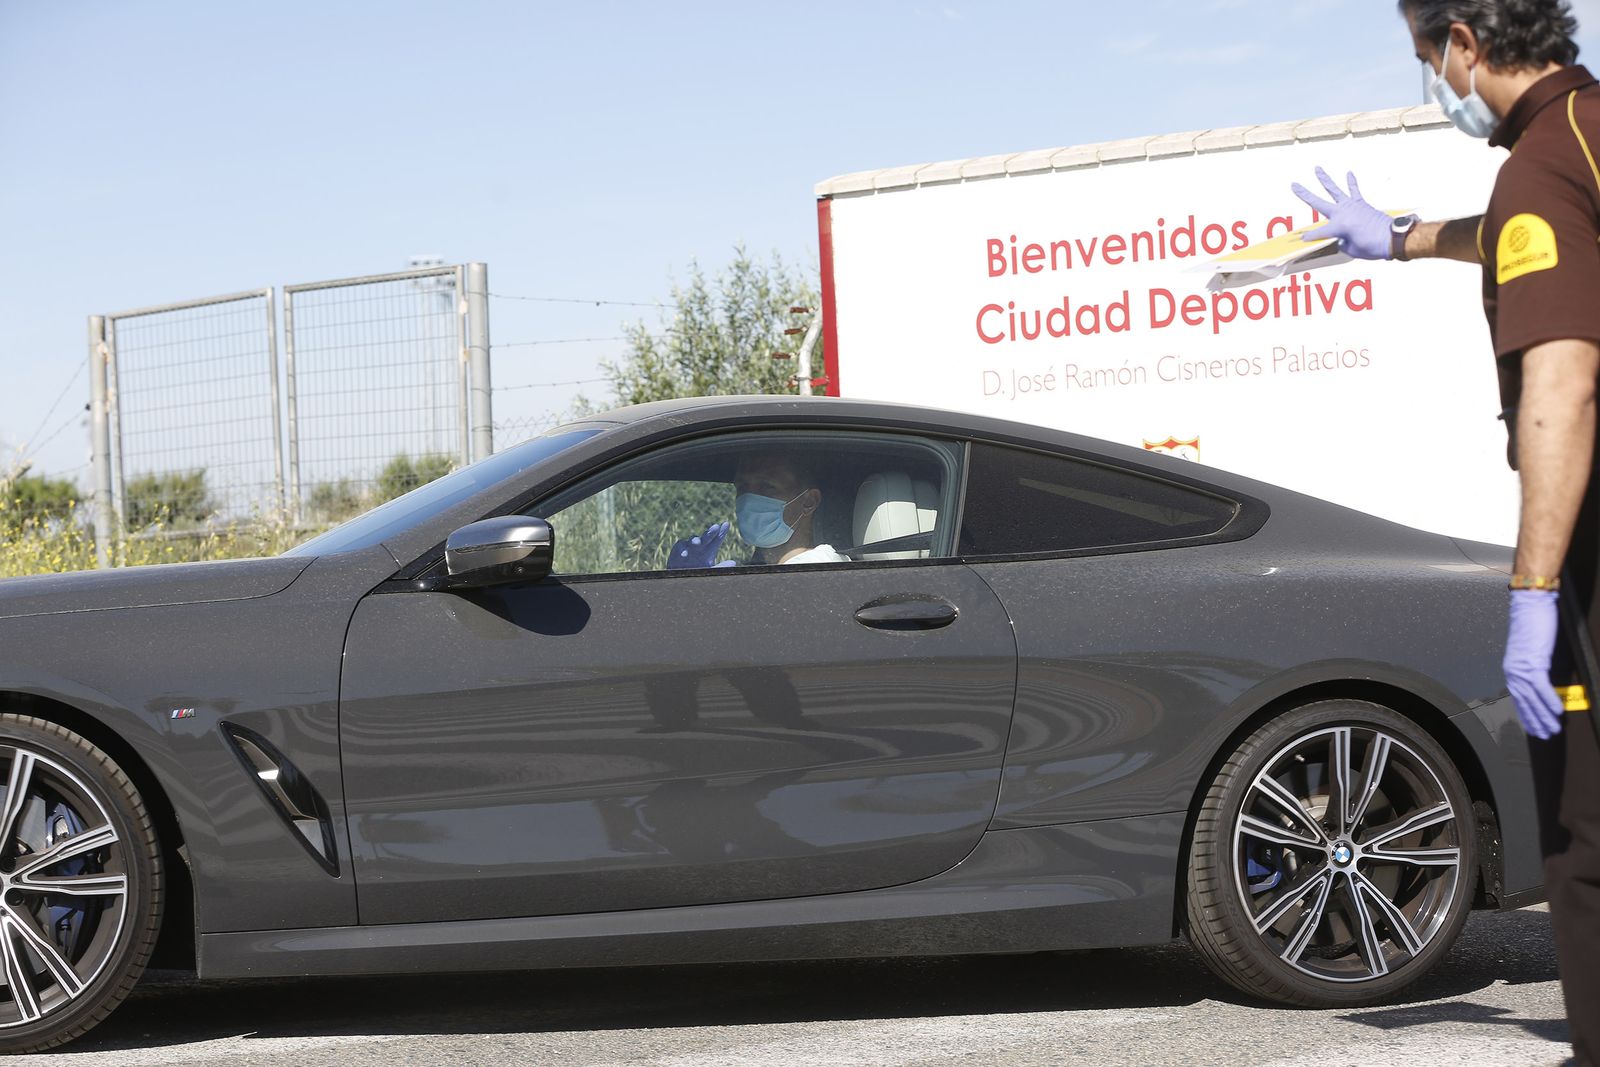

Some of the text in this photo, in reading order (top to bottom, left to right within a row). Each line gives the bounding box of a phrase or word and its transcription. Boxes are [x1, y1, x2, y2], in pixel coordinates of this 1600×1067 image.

[986, 214, 1249, 278] Bienvenidos
[976, 272, 1374, 344] Ciudad Deportiva
[1066, 359, 1146, 390] Ramón
[1157, 354, 1262, 382] Cisneros
[1272, 342, 1371, 374] Palacios
